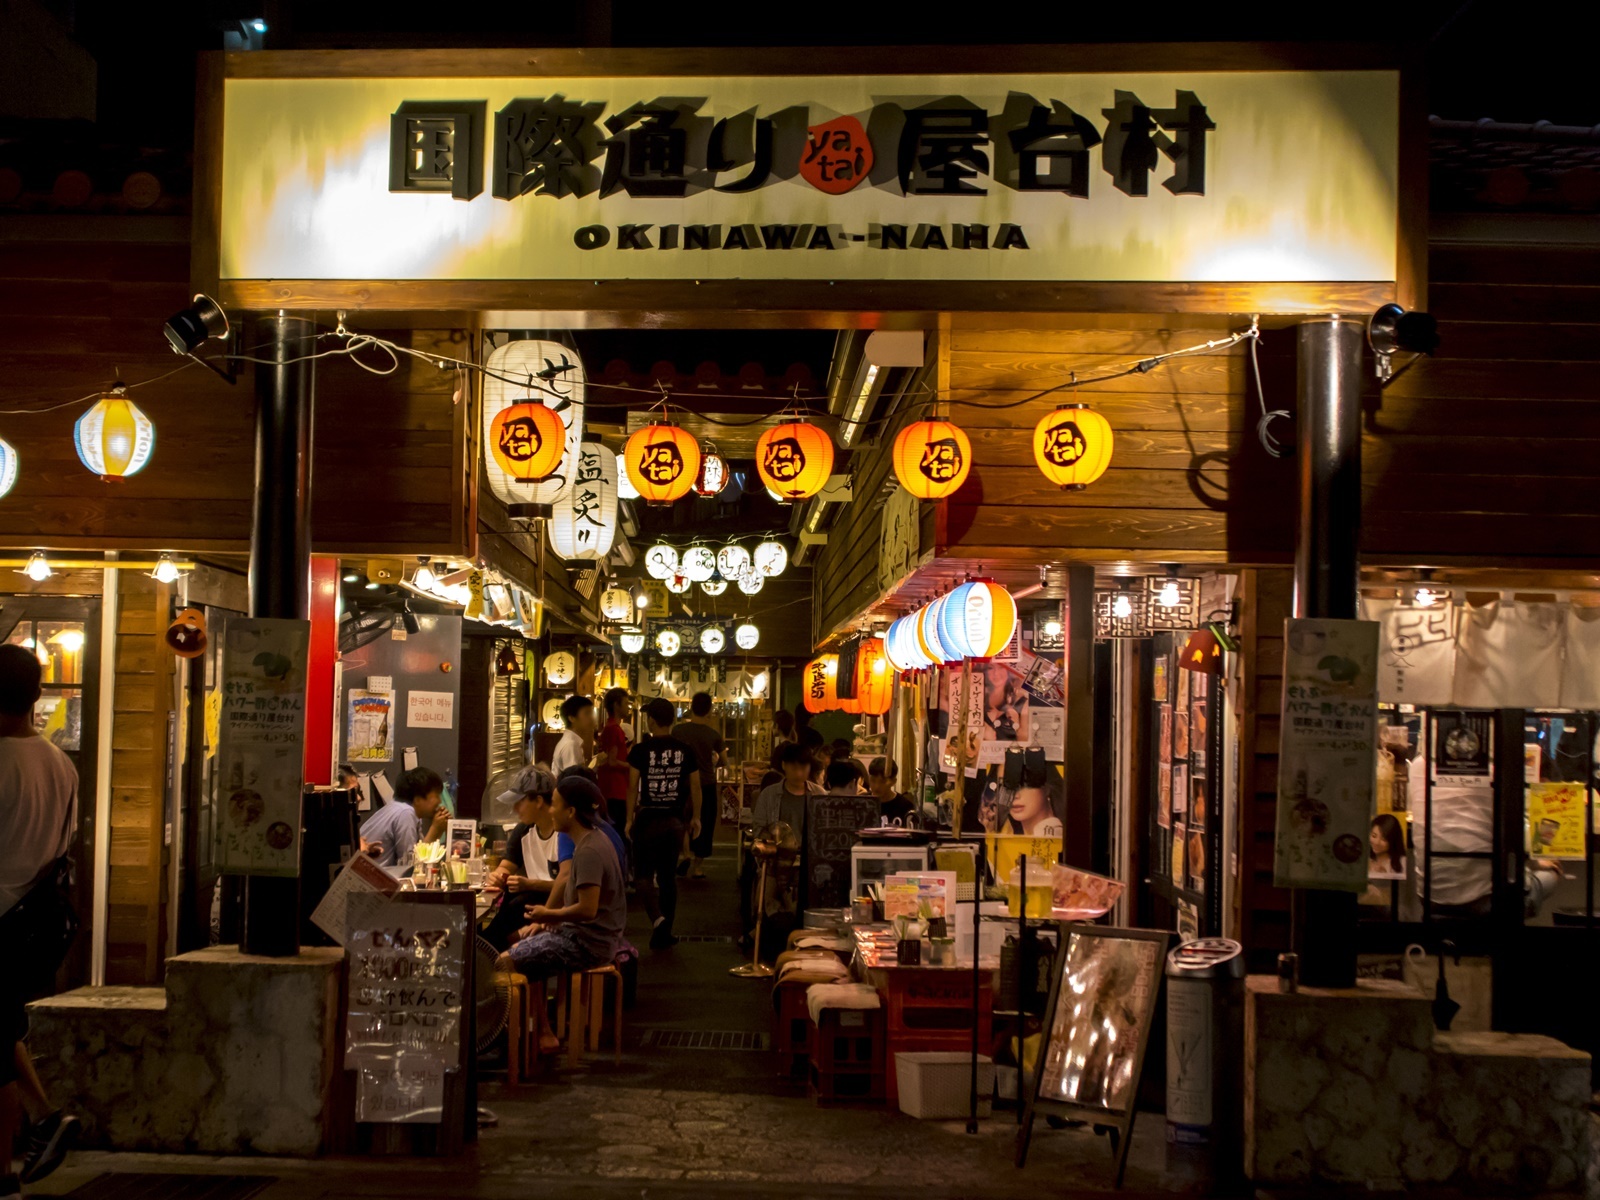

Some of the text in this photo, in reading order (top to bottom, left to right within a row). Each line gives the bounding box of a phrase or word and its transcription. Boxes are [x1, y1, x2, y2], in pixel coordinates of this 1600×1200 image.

[389, 95, 1216, 201] 国際通り 屋台村
[967, 596, 985, 643] Orion
[410, 697, 451, 708] 한국어 메뉴
